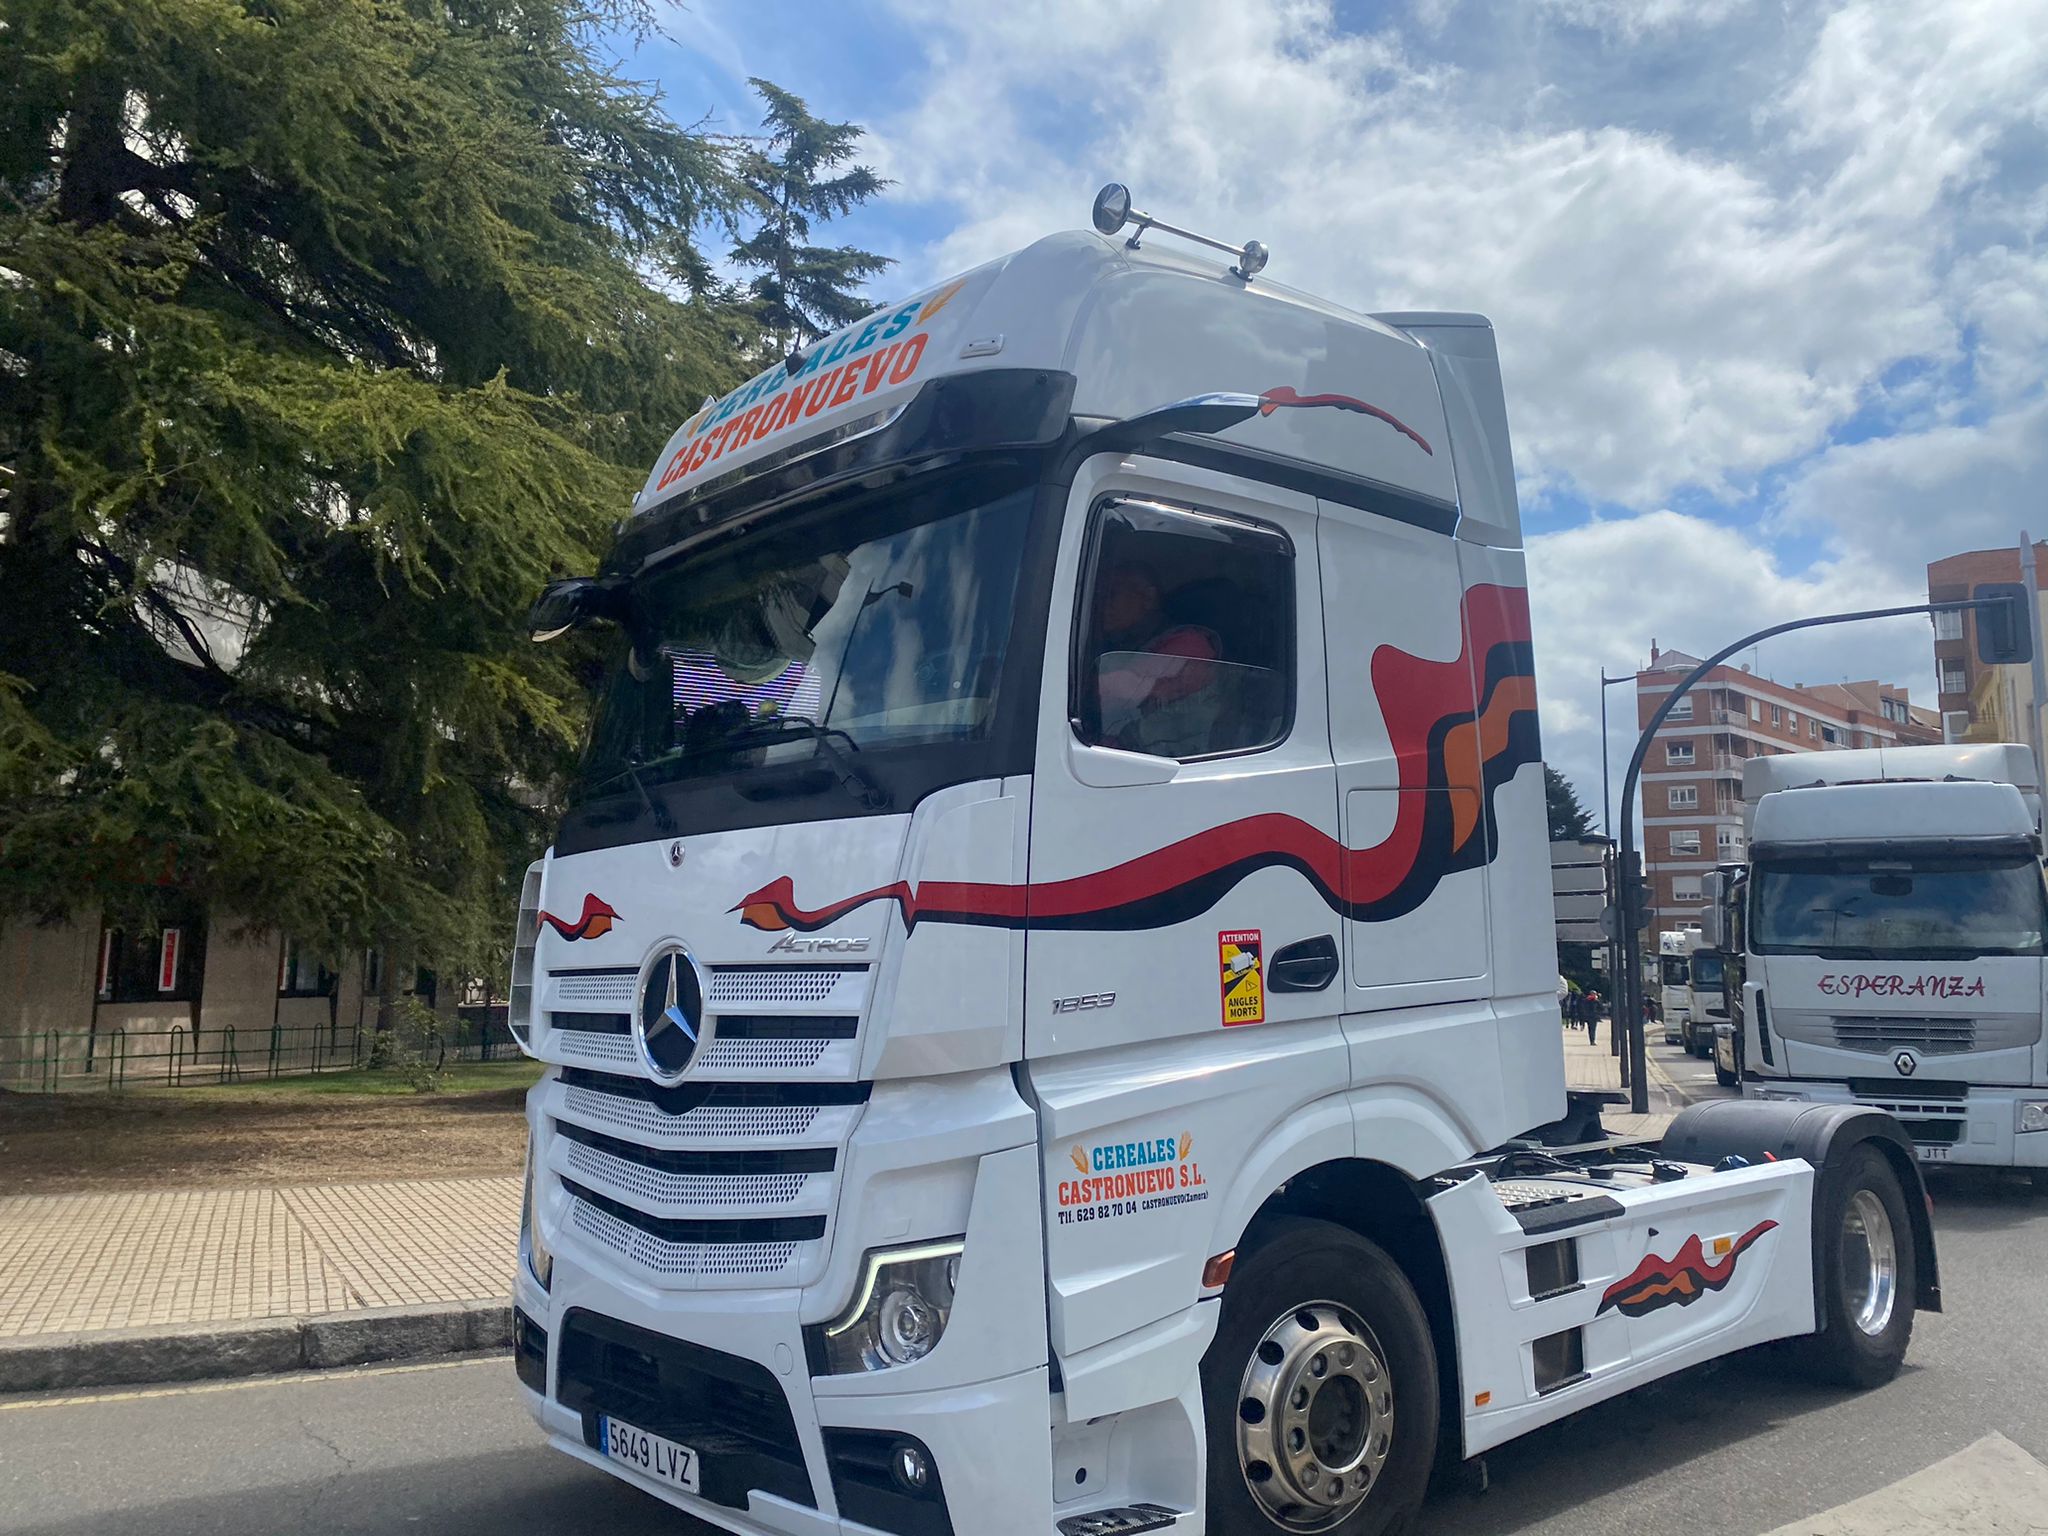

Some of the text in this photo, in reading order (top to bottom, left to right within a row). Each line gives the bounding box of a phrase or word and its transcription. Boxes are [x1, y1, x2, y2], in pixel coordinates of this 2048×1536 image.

[656, 333, 929, 492] CASTRONUEVO
[1221, 933, 1259, 942] ATTENTION
[1817, 975, 1986, 998] ESPERANZA
[1052, 991, 1116, 1015] 1853
[1228, 996, 1258, 1007] ANGLES
[1230, 1007, 1257, 1017] MORTS
[1093, 1138, 1176, 1171] CEREALES
[1058, 1164, 1206, 1206] CASTRONUEVO S.L.
[1077, 1205, 1095, 1222] 629
[1098, 1204, 1110, 1219] 82
[1112, 1202, 1123, 1217] 70
[1126, 1200, 1137, 1214] 04
[610, 1423, 691, 1486] 5649 LVZ
